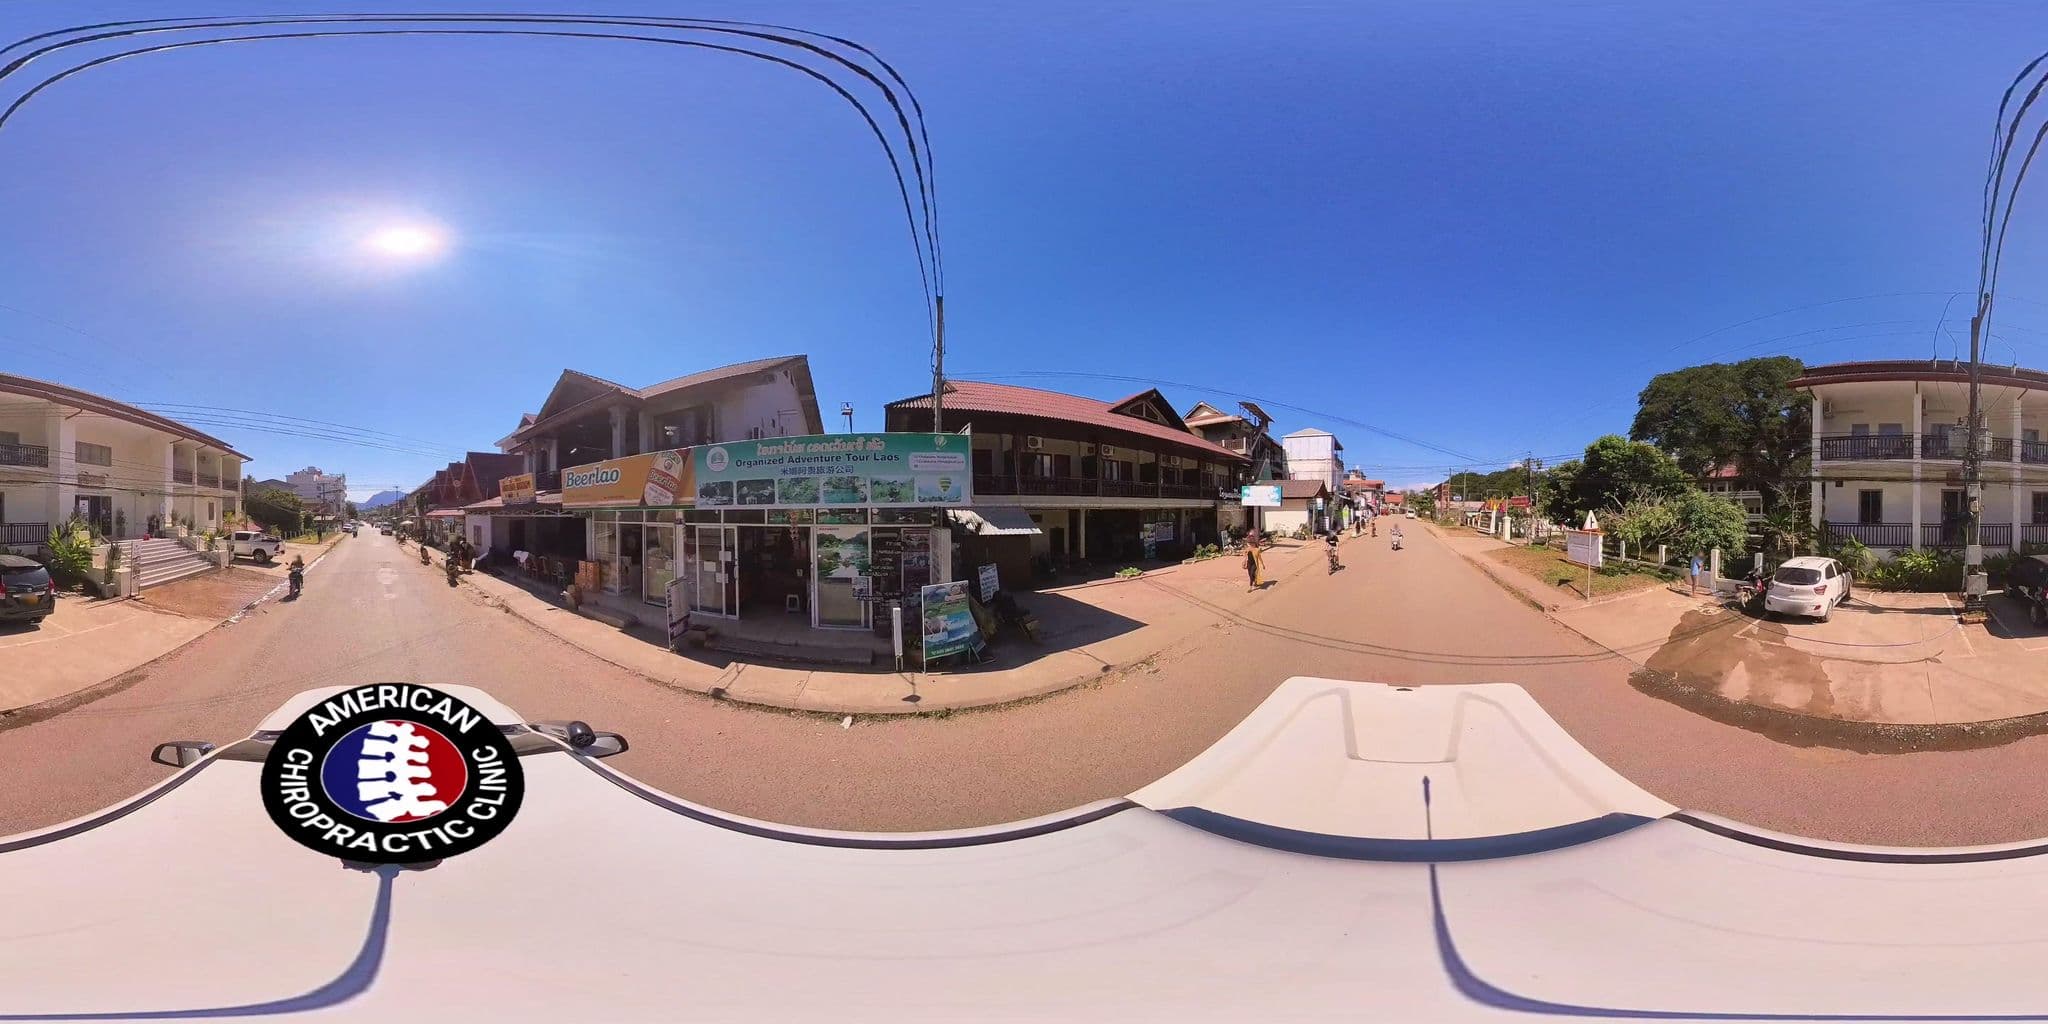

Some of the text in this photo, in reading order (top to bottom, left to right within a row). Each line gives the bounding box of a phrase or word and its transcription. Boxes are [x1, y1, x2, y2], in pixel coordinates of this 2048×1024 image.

[736, 452, 900, 468] Organized Adventure Tour Laos
[566, 468, 621, 488] Beerlao
